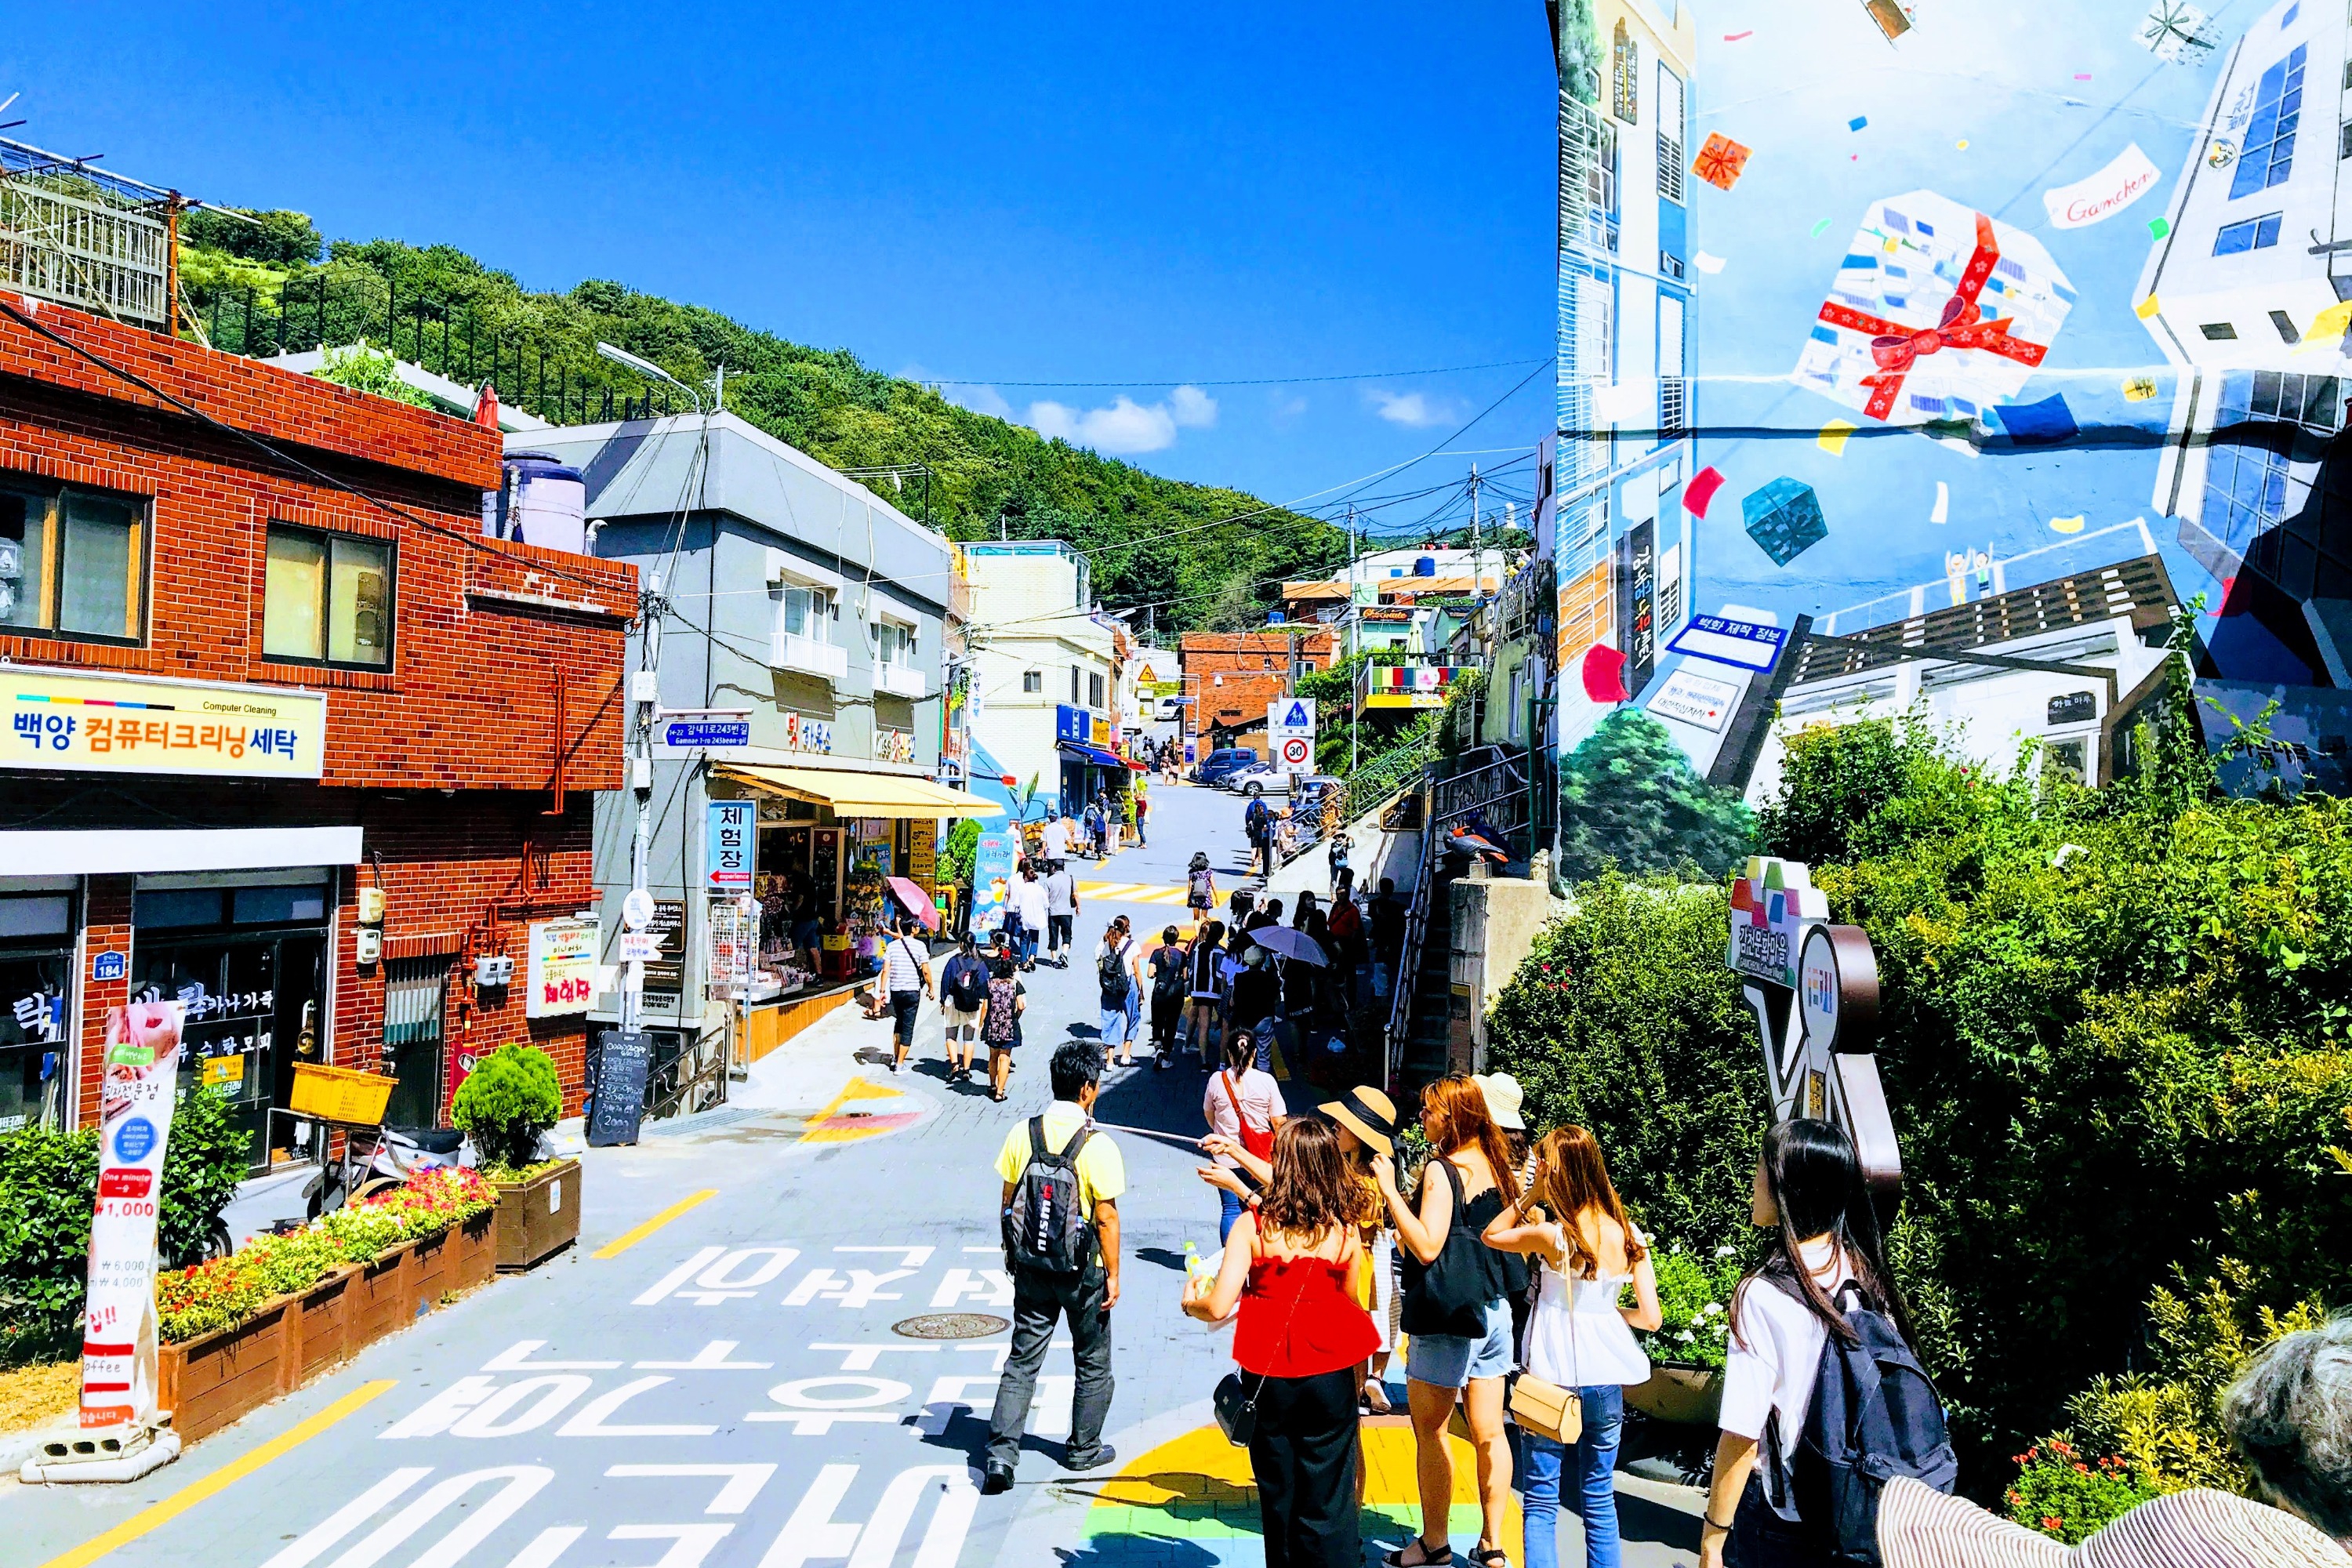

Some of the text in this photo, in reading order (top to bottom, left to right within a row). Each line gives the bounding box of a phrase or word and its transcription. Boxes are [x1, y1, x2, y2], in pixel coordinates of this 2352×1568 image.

[1697, 617, 1782, 643] 벽화 제작 정보
[203, 701, 278, 717] Computer Cleaning
[13, 712, 298, 760] 백양 컴퓨터크리닝 세탁
[1290, 746, 1303, 757] 30
[720, 807, 743, 868] 체험장
[1739, 926, 1788, 967] 감천문화마을
[99, 965, 120, 977] 184
[243, 989, 274, 1010] 가죽
[13, 992, 53, 1036] 탁
[240, 1033, 272, 1053] 모피
[103, 1173, 150, 1182] One minute
[1036, 1185, 1054, 1252] nismo
